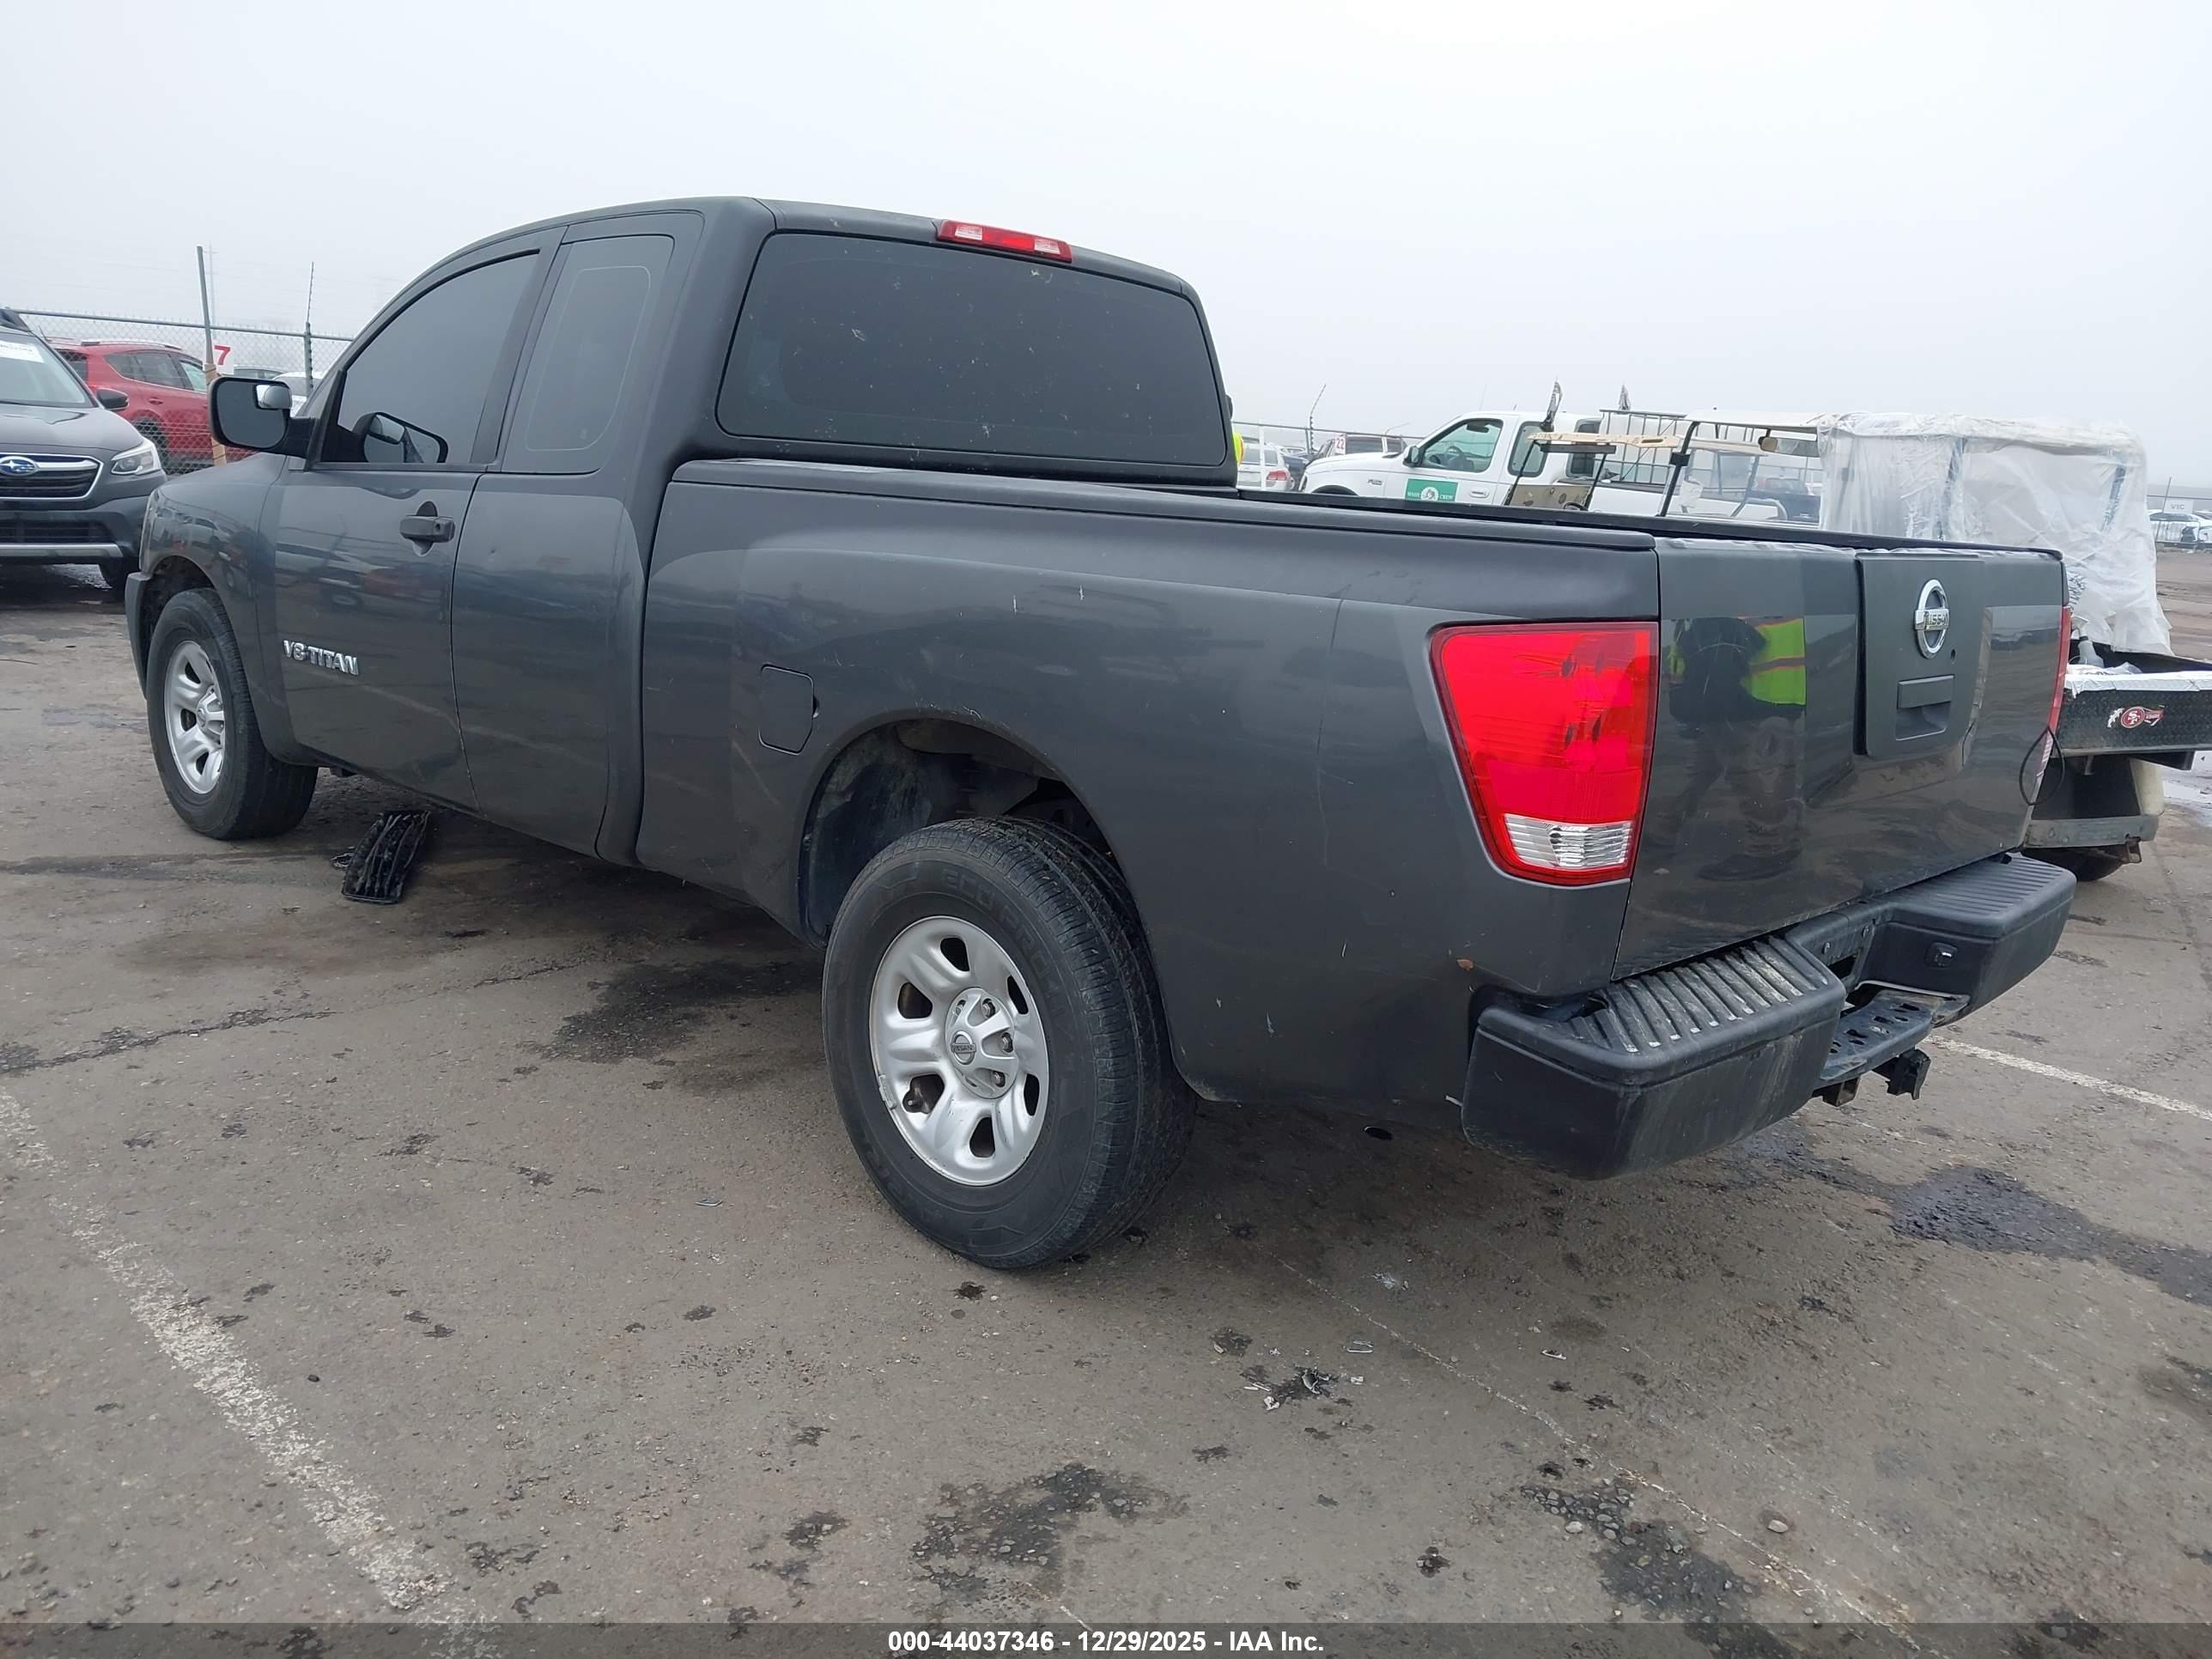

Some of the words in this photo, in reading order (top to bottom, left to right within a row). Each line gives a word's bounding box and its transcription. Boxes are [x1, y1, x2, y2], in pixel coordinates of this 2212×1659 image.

[215, 345, 231, 365] 7
[1336, 438, 1345, 450] 22
[307, 646, 359, 676] TITAN
